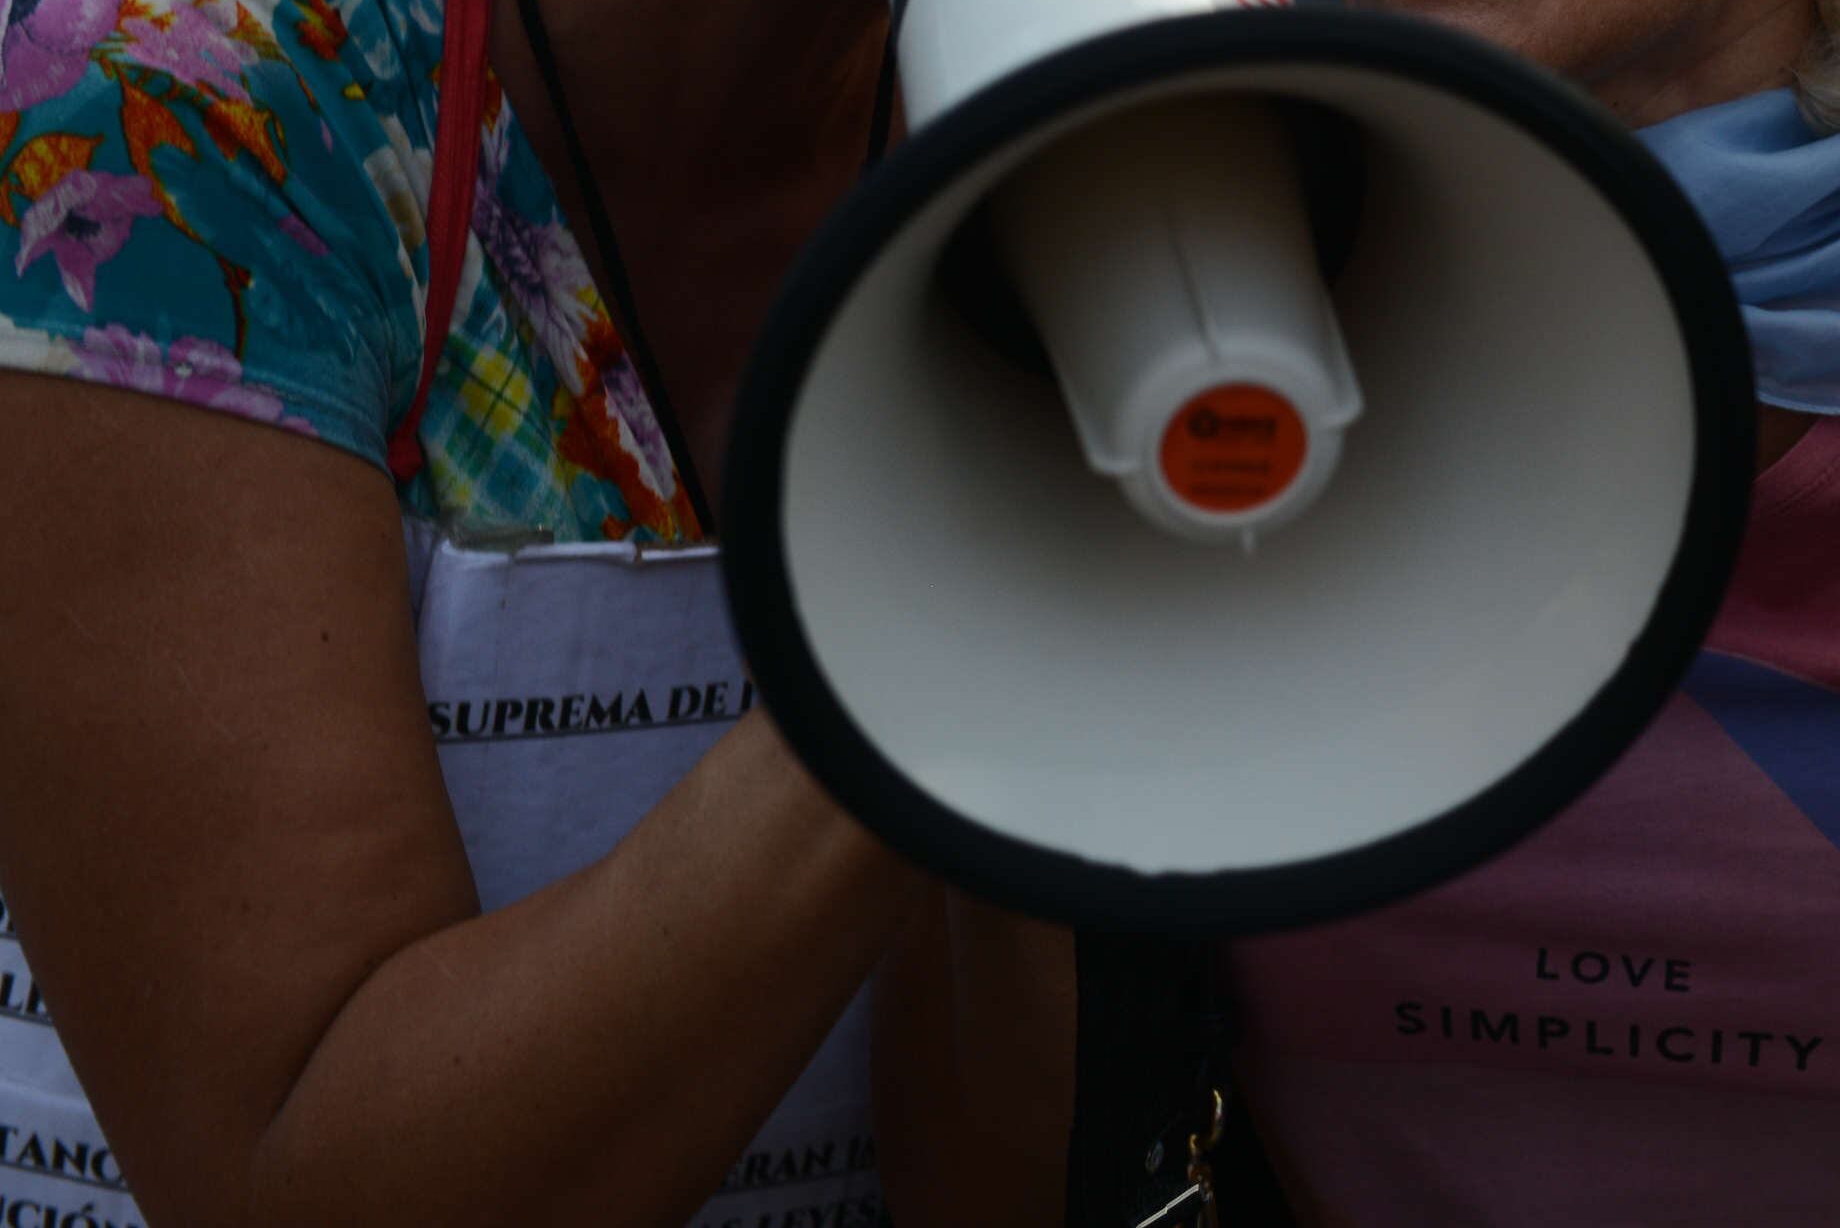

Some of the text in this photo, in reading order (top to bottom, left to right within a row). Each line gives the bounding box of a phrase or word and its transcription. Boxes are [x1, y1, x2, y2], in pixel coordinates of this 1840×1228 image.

[428, 687, 653, 736] SUPREMA
[666, 681, 729, 721] DE
[1536, 947, 1692, 992] LOVE
[1394, 1002, 1823, 1071] SIMPLICITY
[724, 1139, 835, 1189] RAN
